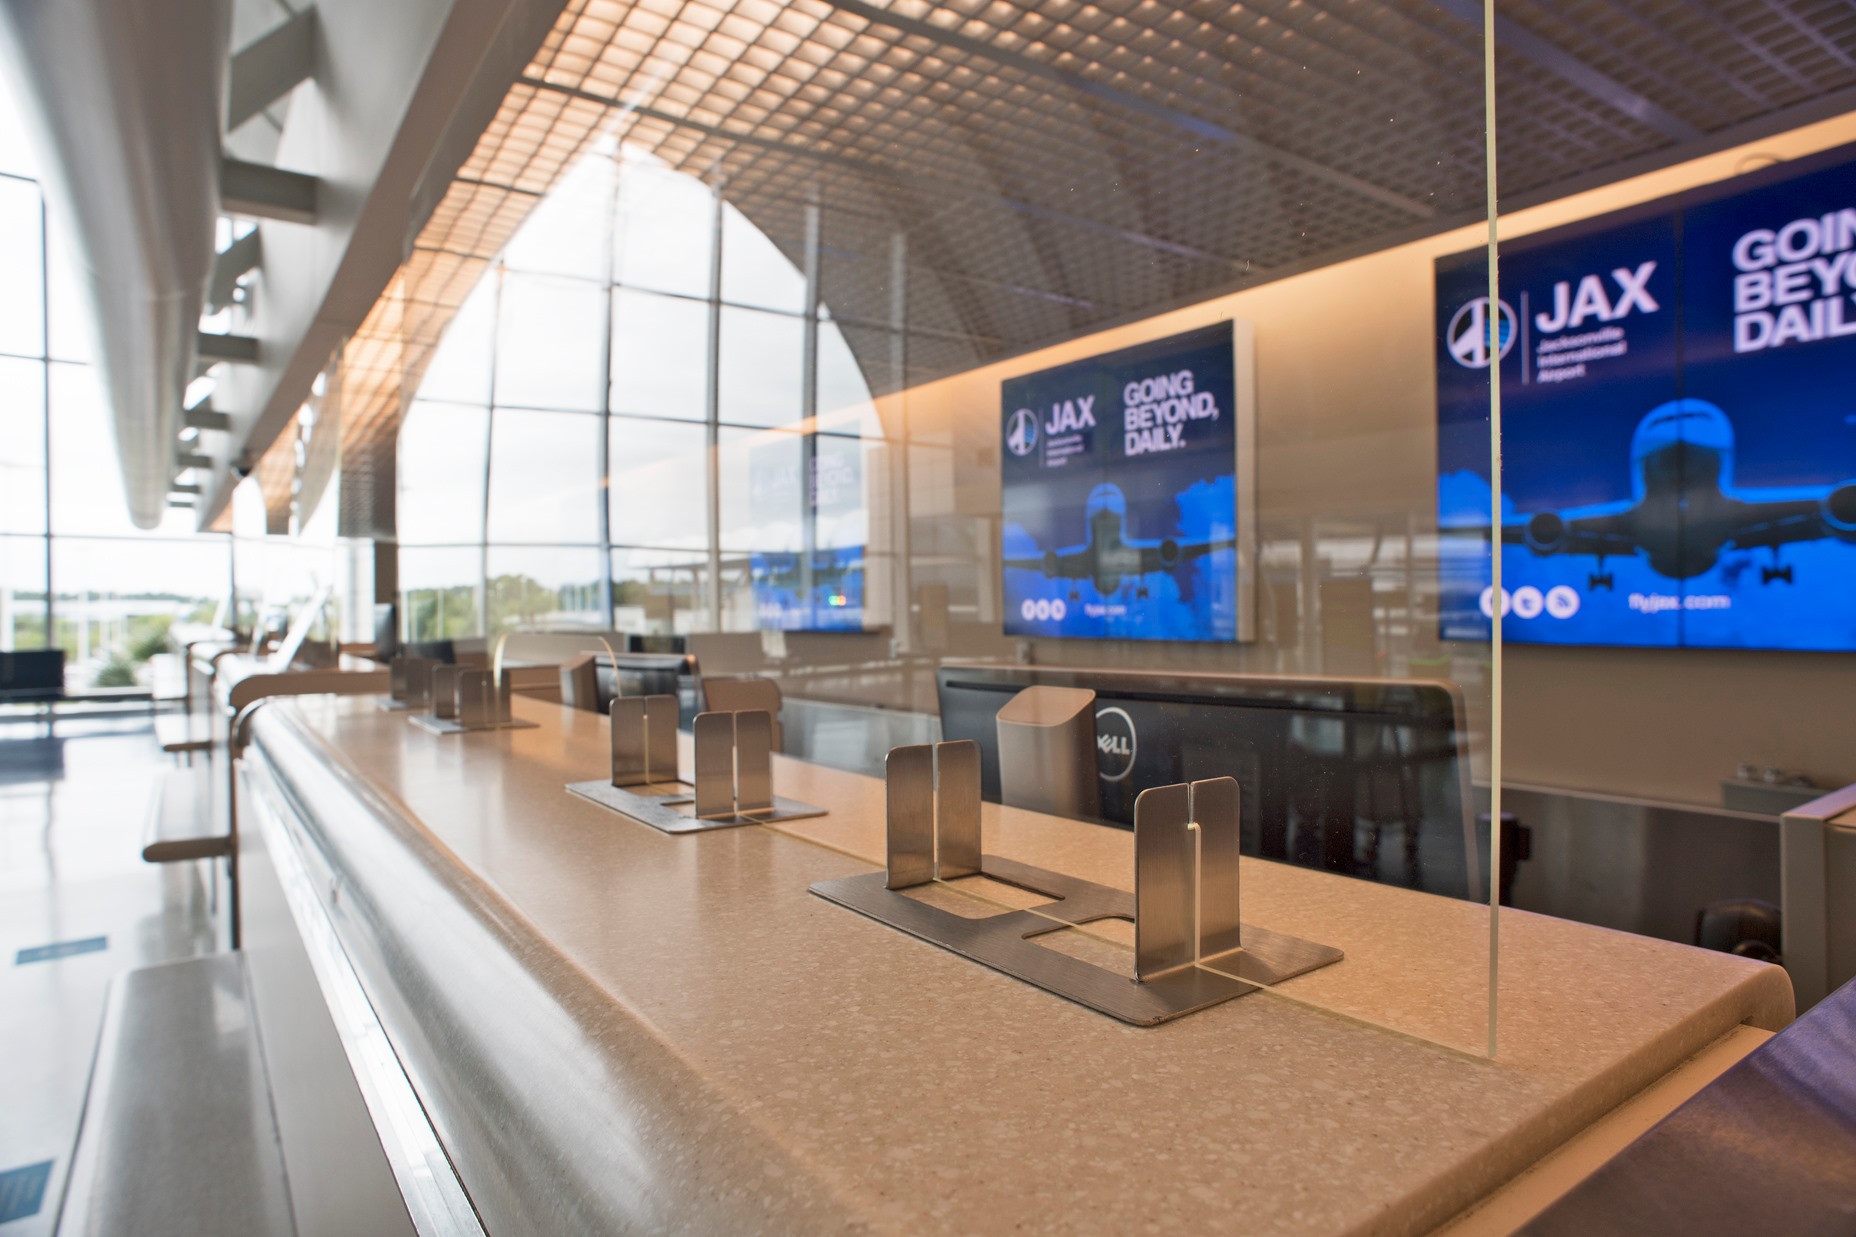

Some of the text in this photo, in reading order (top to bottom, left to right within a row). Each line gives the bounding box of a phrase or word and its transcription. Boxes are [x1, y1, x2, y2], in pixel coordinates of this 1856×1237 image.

[1535, 260, 1659, 333] JAX
[1734, 251, 1856, 314] BEY
[1734, 292, 1856, 353] DAIL
[1123, 369, 1193, 407] GOING
[1045, 394, 1096, 435] JAX
[1125, 391, 1219, 431] BEYOND,
[1125, 422, 1186, 456] DAILY.
